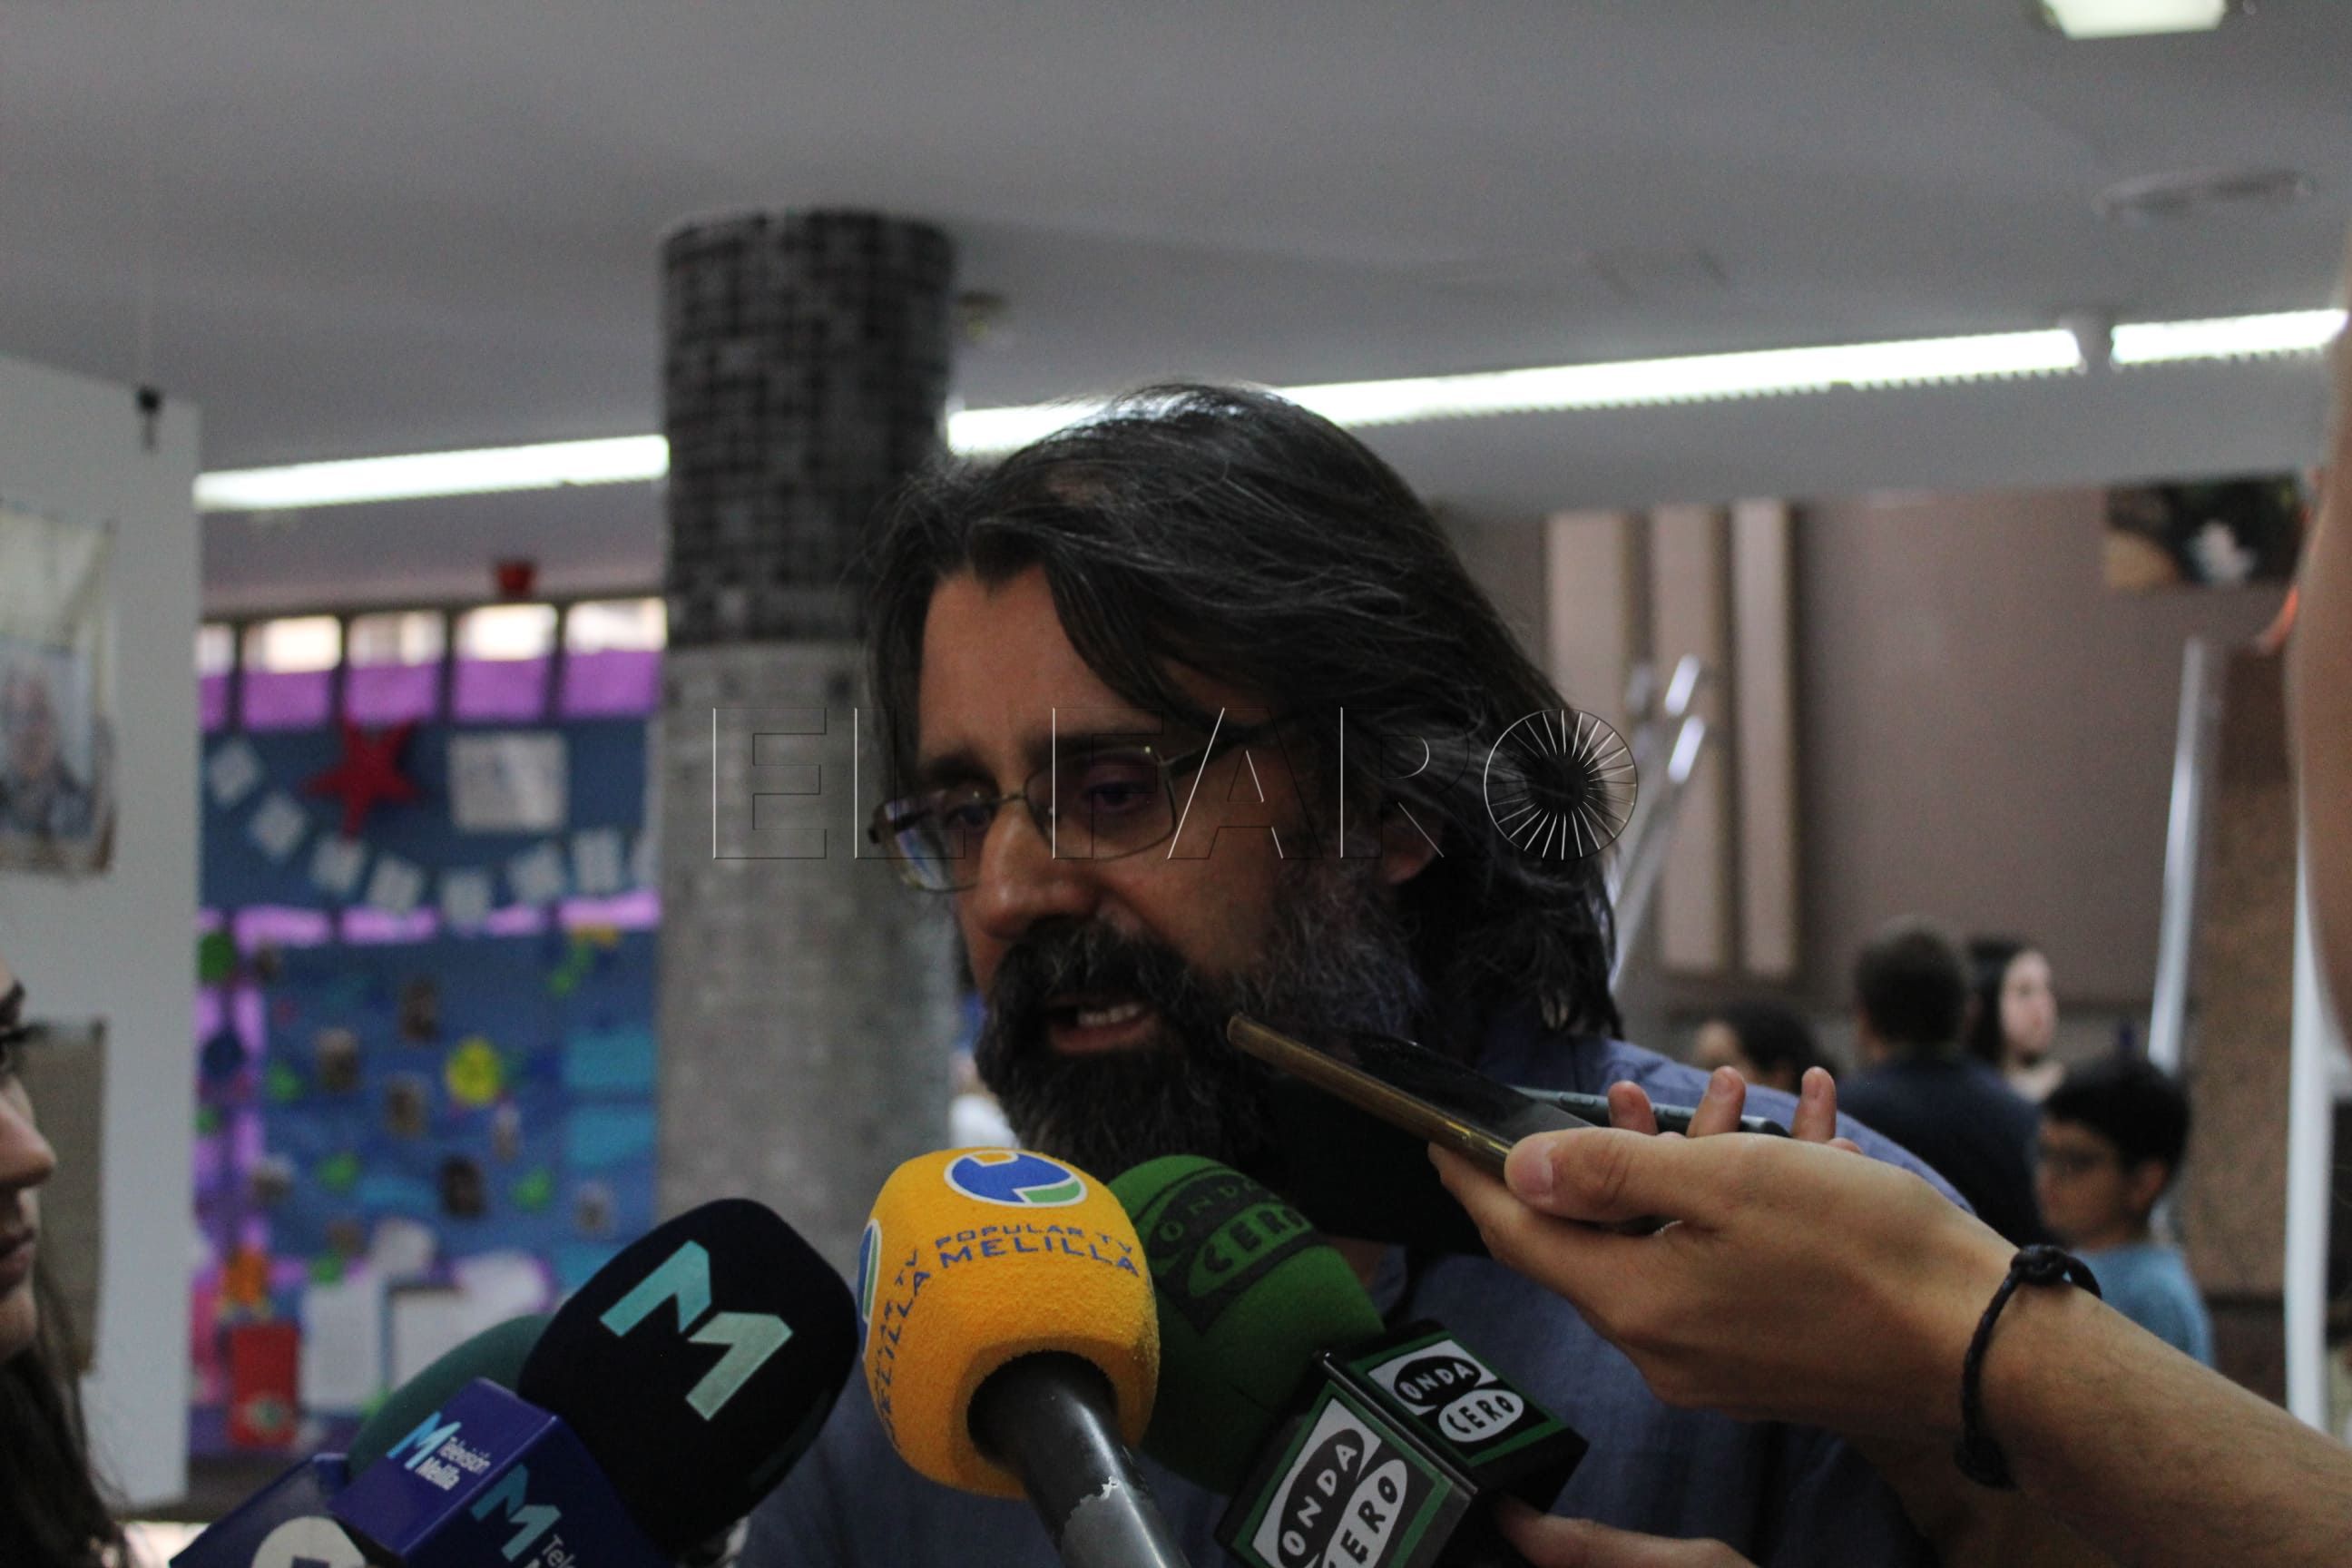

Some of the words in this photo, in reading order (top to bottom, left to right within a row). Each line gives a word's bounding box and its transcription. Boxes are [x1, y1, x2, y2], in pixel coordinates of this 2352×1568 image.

[935, 1223, 1085, 1250] POPULAR
[1094, 1231, 1133, 1254] TV
[938, 1236, 1140, 1278] MELILLA
[1398, 1362, 1475, 1401] ONDA
[1446, 1395, 1516, 1436] CERO
[1281, 1444, 1359, 1557] ONDA
[1328, 1475, 1398, 1568] ERO
